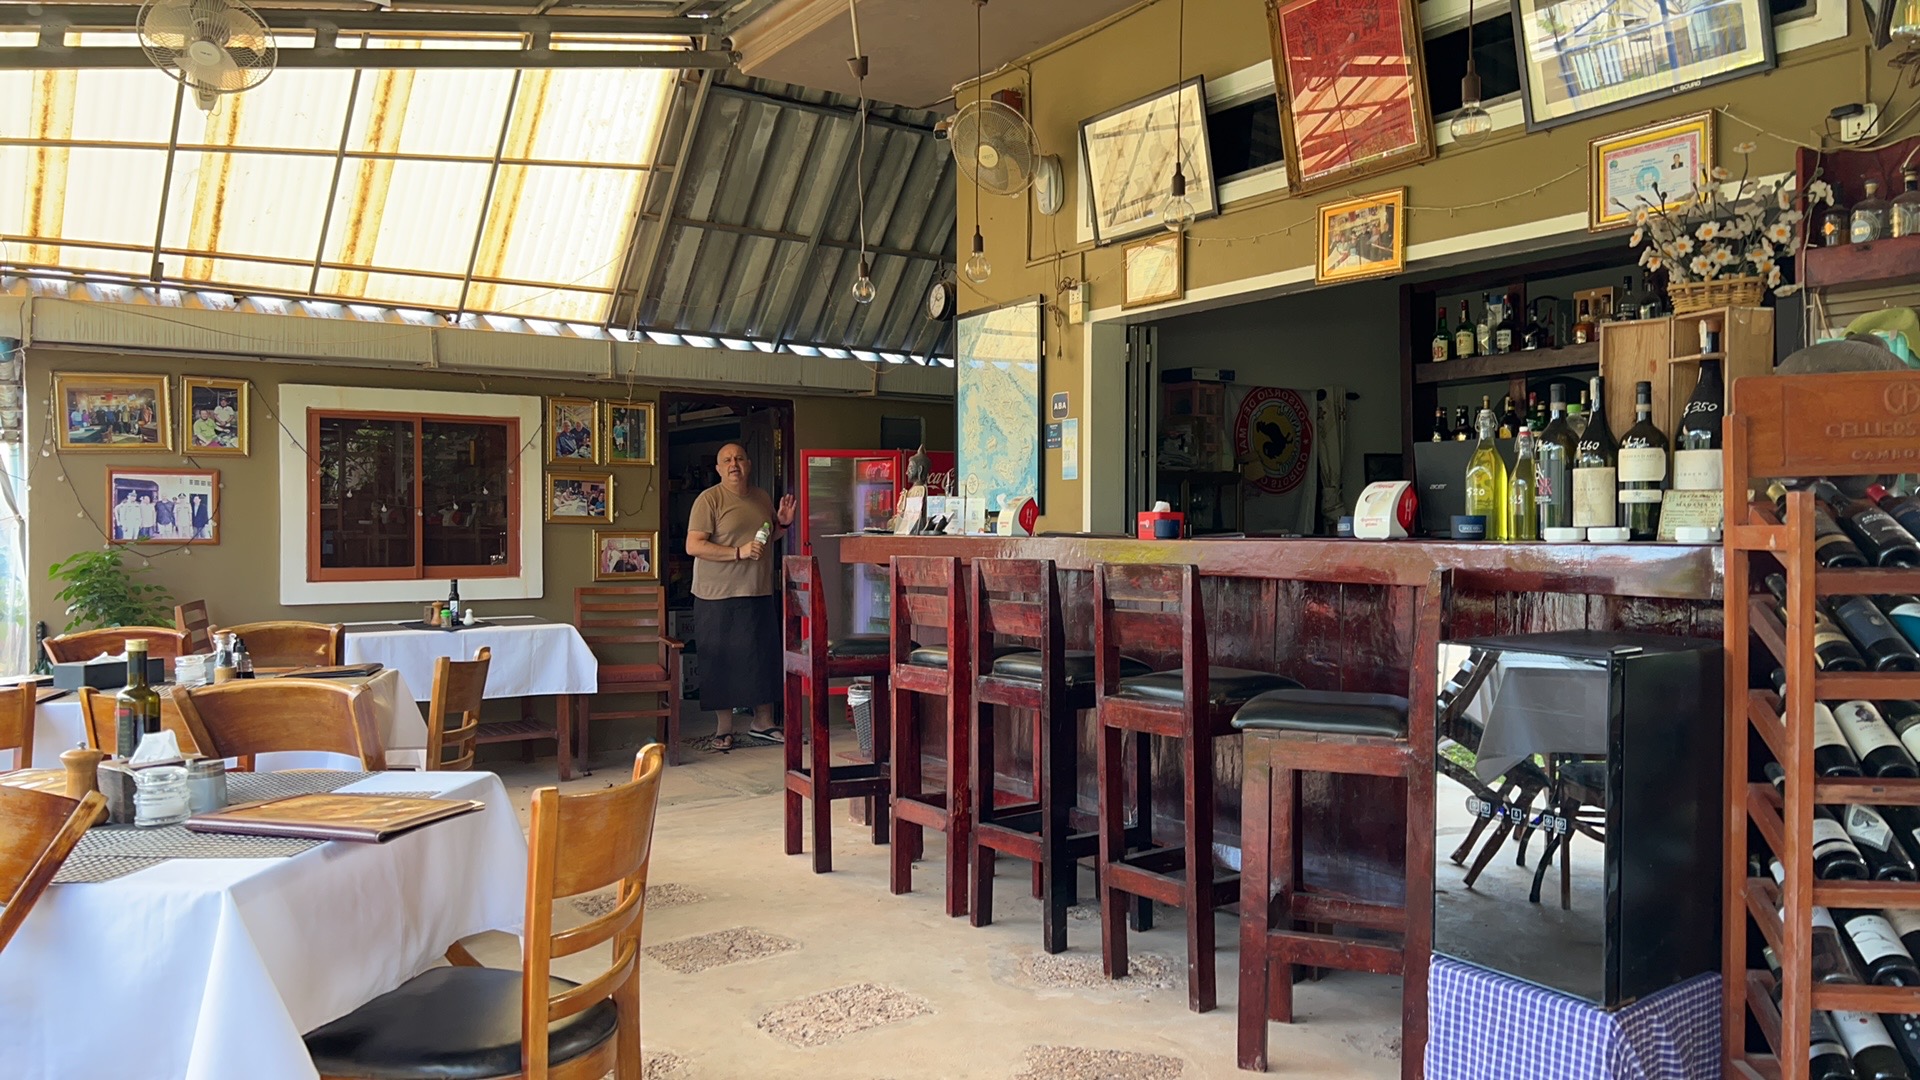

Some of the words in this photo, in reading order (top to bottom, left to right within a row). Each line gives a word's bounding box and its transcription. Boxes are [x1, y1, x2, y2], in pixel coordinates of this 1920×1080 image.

[1054, 402, 1067, 410] ABA
[1683, 401, 1718, 418] $350
[1577, 440, 1600, 451] $160
[1466, 487, 1485, 498] $20
